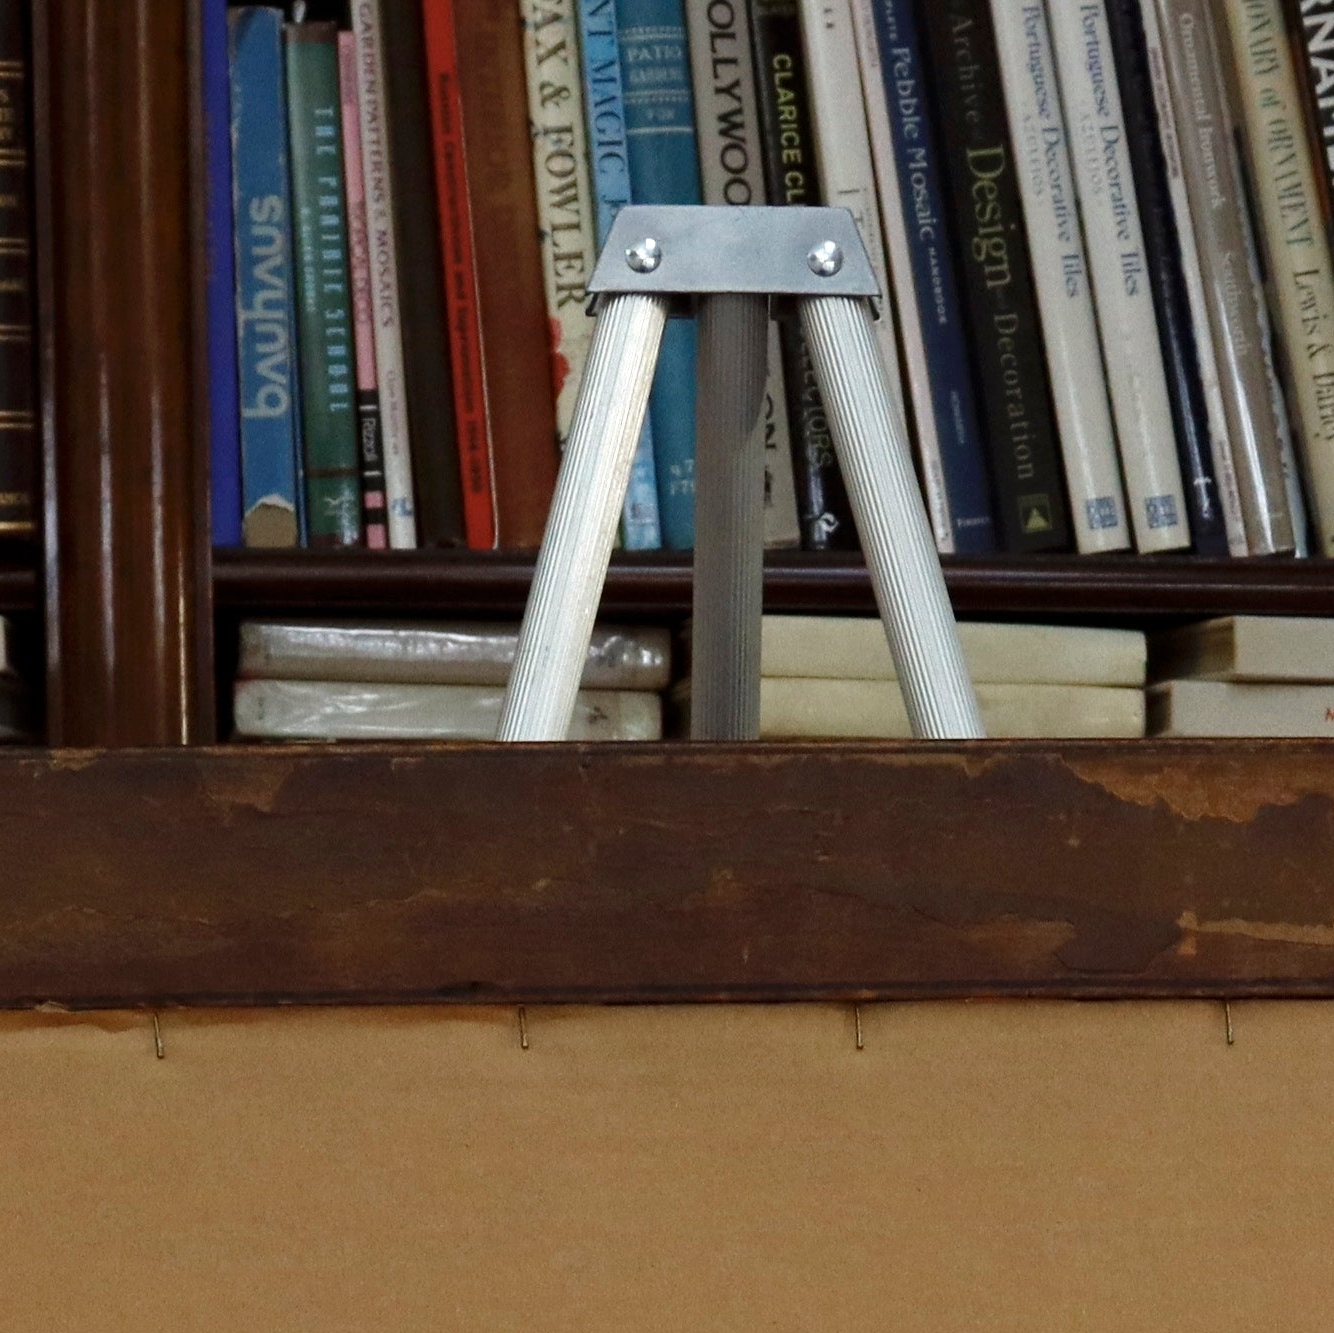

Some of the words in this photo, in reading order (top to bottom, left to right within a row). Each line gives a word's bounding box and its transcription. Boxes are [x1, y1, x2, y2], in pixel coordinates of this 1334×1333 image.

[539, 82, 572, 109] &
[591, 57, 626, 174] MAGIC
[773, 53, 802, 165] CLARICE
[1021, 5, 1053, 120] Portuguese
[1041, 126, 1073, 243] Decorative
[1062, 254, 1084, 300] Tiles
[1080, 3, 1112, 118] Portuguese
[1099, 125, 1133, 242] Decorative
[1121, 251, 1143, 298] Tiles
[543, 122, 587, 311] FOWLER
[892, 47, 921, 139] Pebble
[907, 146, 937, 242] Mosaic
[929, 246, 947, 325] HANDBOOK
[949, 13, 981, 124] Archive
[965, 144, 1017, 290] Design
[991, 312, 1038, 481] Decoration
[1267, 118, 1314, 248] ORNAMENT
[240, 194, 289, 419] bauhaus
[1292, 269, 1323, 336] Lewis
[1306, 342, 1331, 360] &
